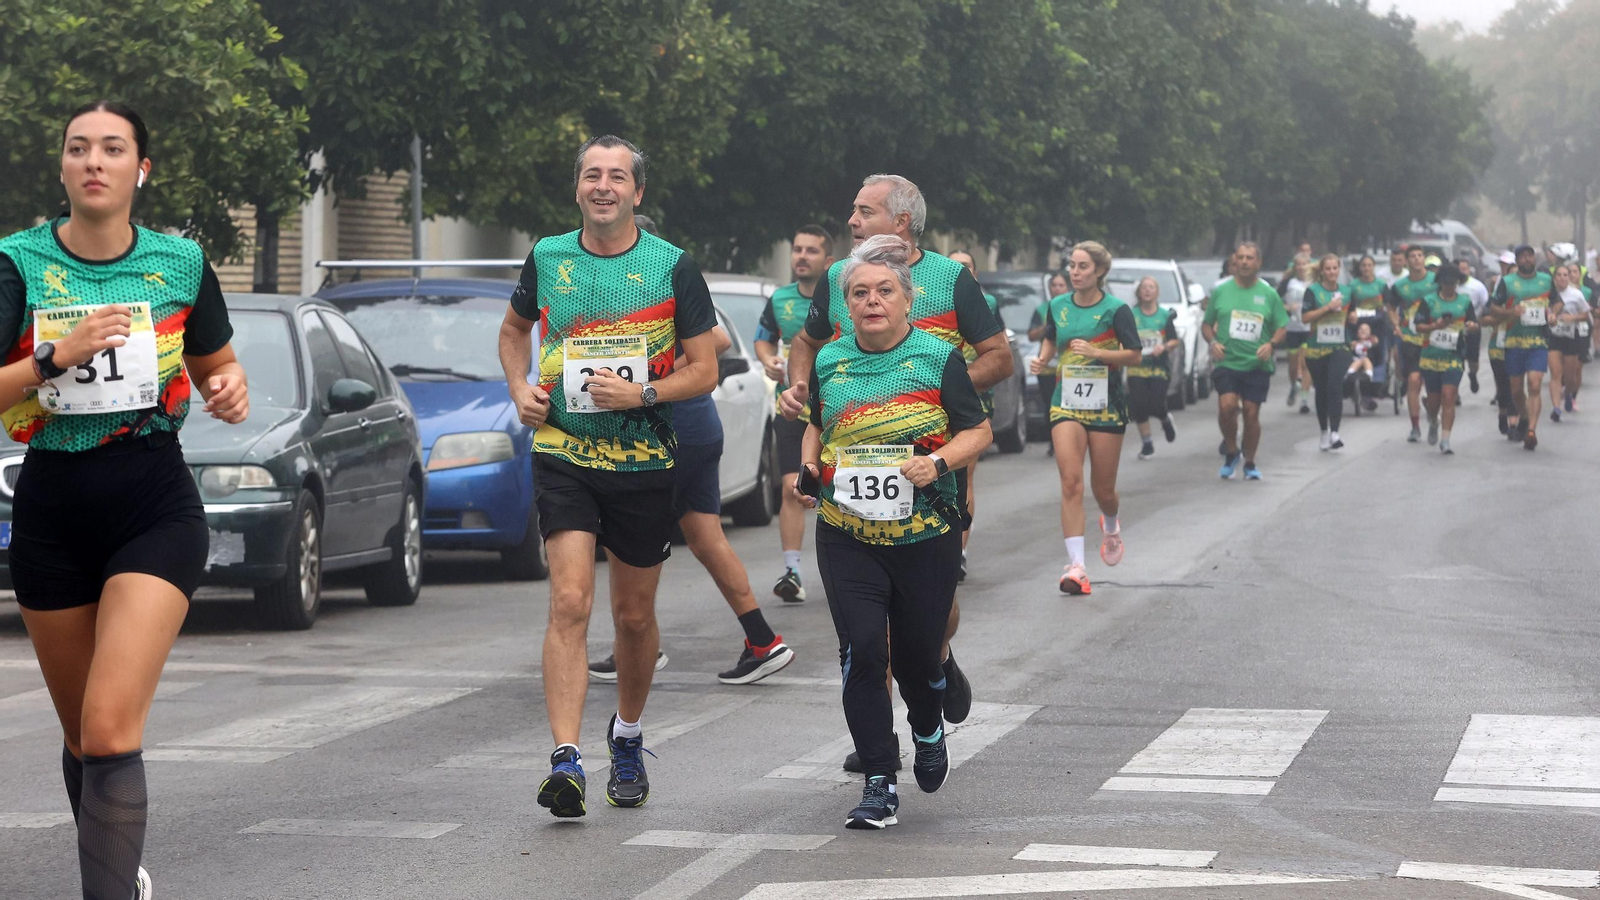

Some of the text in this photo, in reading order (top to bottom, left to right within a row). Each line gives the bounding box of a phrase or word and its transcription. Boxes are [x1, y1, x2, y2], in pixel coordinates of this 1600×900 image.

[47, 309, 89, 321] CARRERA
[1236, 321, 1257, 334] 212
[604, 337, 641, 345] SOLIDARIA
[74, 347, 124, 384] 31
[580, 365, 634, 393] 29
[1074, 383, 1094, 398] 47
[849, 475, 900, 501] 136
